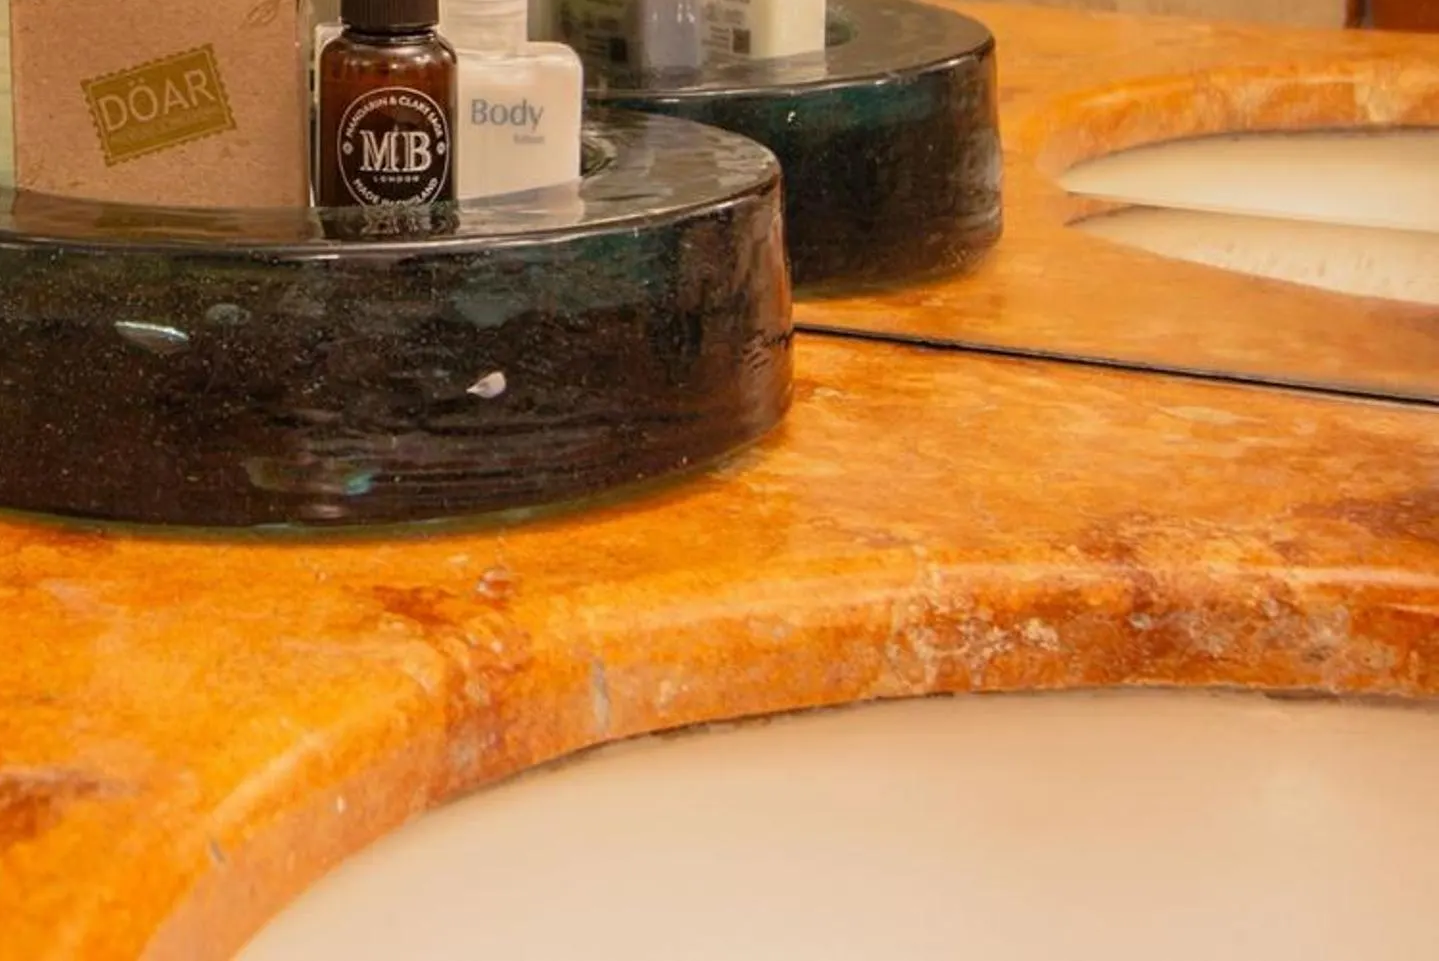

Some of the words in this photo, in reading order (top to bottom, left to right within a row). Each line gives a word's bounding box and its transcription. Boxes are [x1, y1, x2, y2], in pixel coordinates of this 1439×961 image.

[97, 68, 217, 132] DÖAR
[471, 97, 545, 133] Body
[358, 128, 433, 172] MB
[373, 174, 420, 184] LONDON
